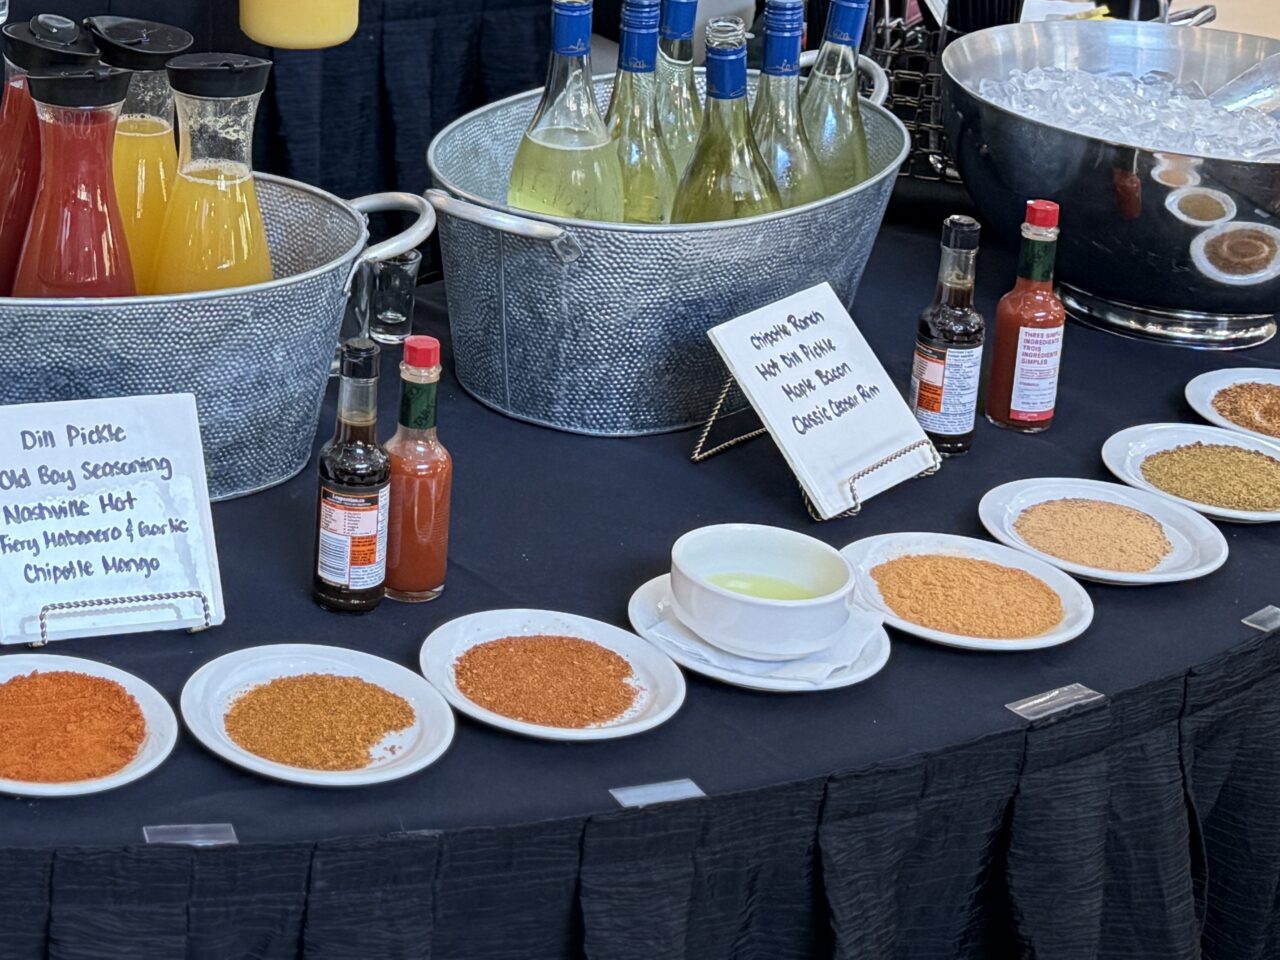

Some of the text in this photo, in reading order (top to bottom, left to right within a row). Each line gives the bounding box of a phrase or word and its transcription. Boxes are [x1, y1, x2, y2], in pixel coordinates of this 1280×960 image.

[787, 310, 825, 334] Ranch
[755, 338, 836, 381] Hot Dill Pickle
[781, 361, 852, 403] Maple Bacon
[792, 405, 832, 435] Classic
[856, 383, 881, 405] Rim
[20, 423, 127, 450] Dill Pickle
[38, 465, 76, 490] Bay
[81, 456, 172, 480] Seasoning
[3, 491, 137, 525] Nashville Hot
[43, 526, 121, 549] Habanero
[24, 555, 160, 584] Chipotle Mango
